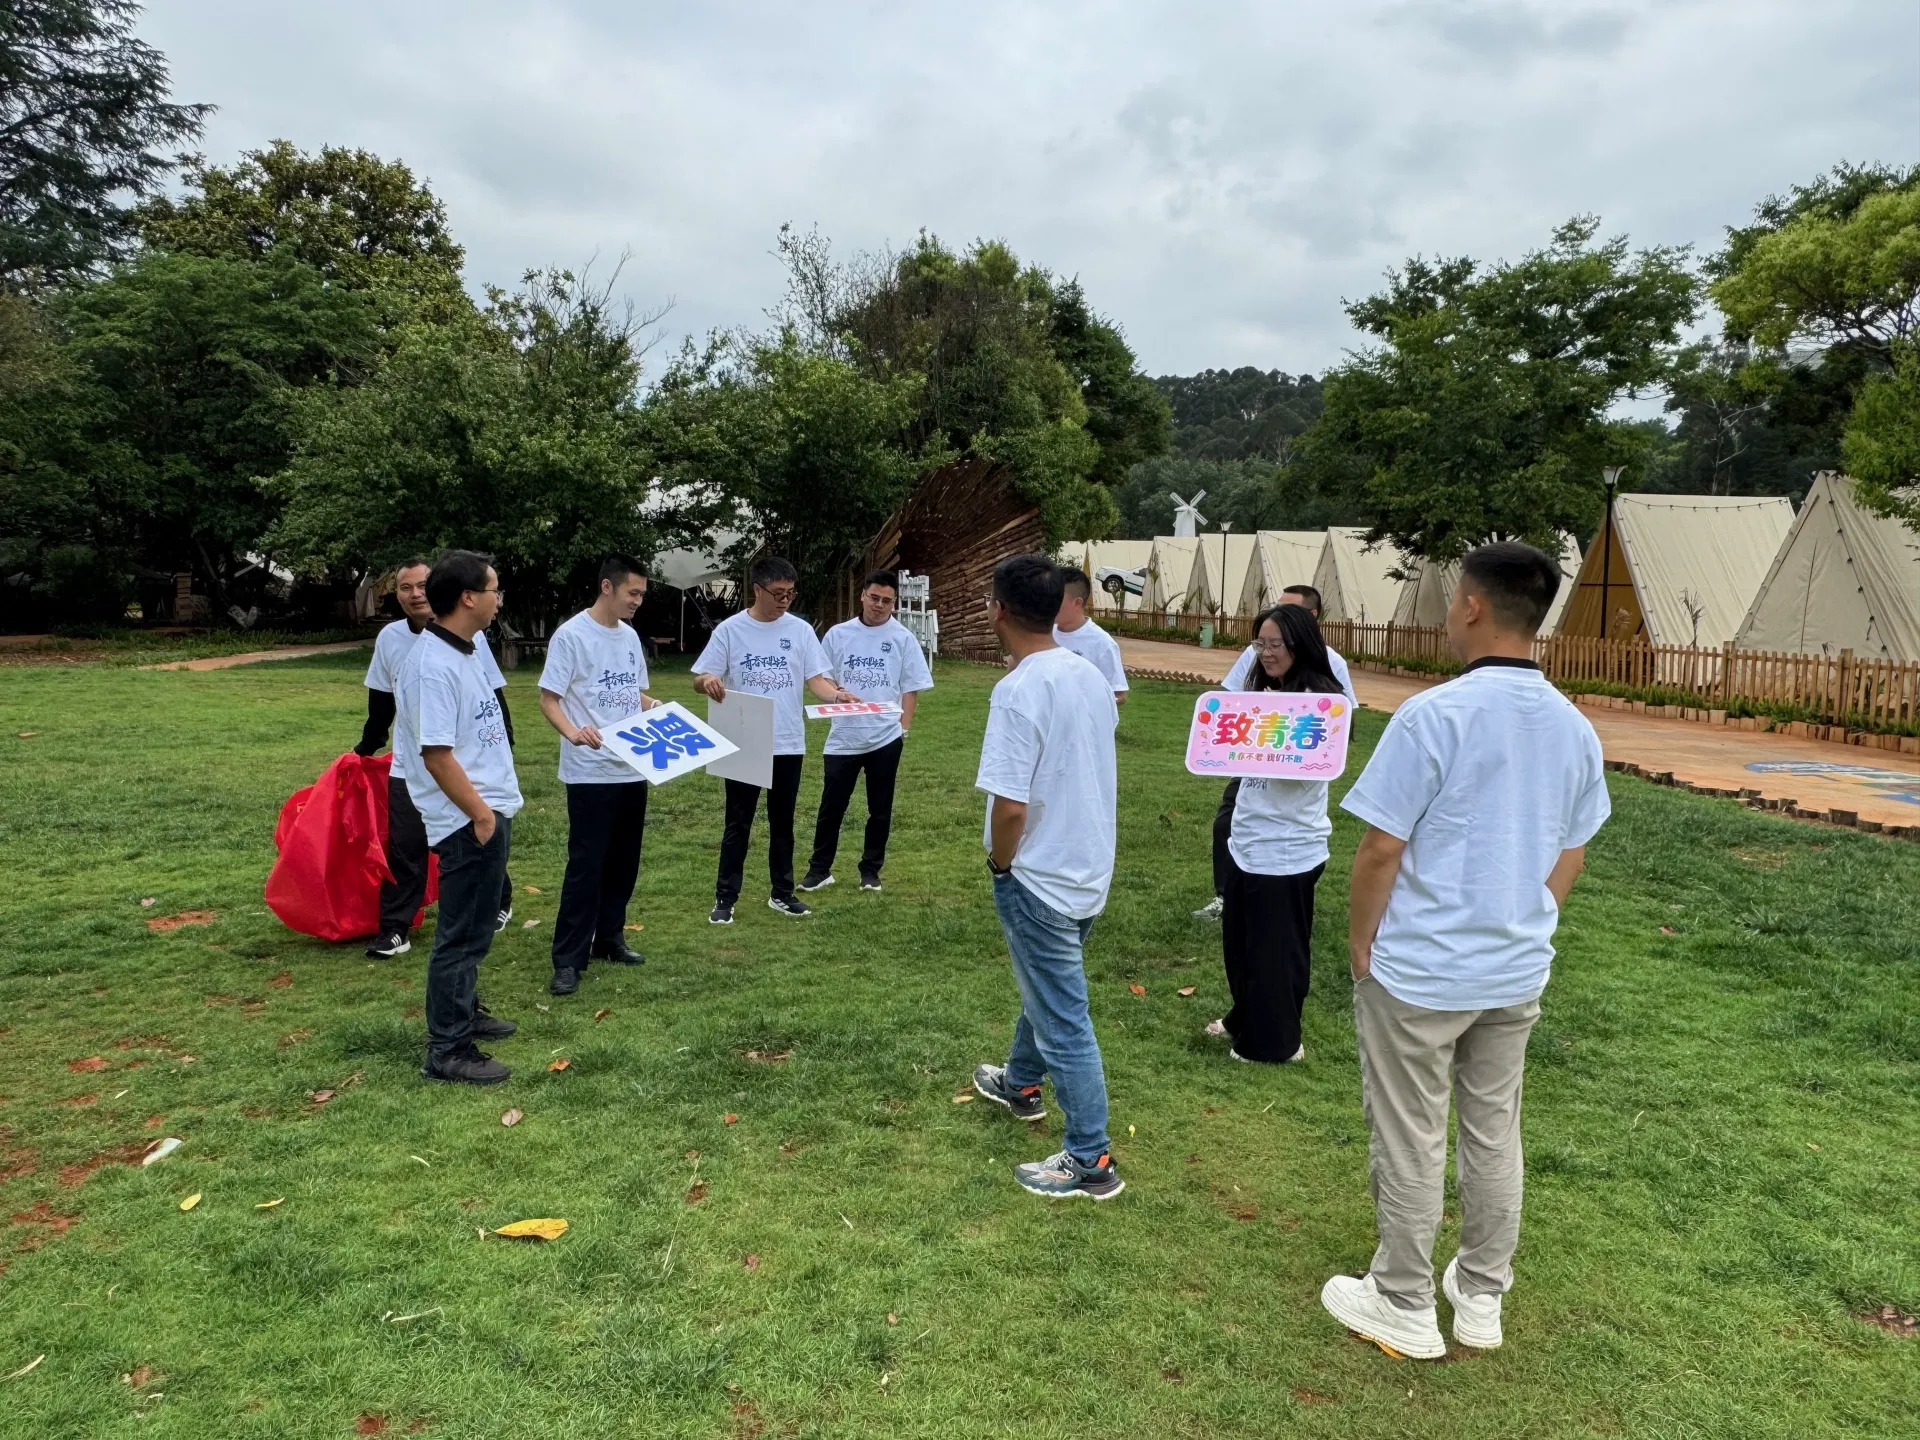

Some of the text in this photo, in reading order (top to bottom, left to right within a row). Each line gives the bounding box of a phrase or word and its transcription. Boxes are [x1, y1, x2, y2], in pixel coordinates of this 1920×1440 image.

[616, 711, 716, 770] 聚
[1211, 711, 1328, 750] 致青春
[1228, 752, 1303, 763] 青春不老 我们不散
